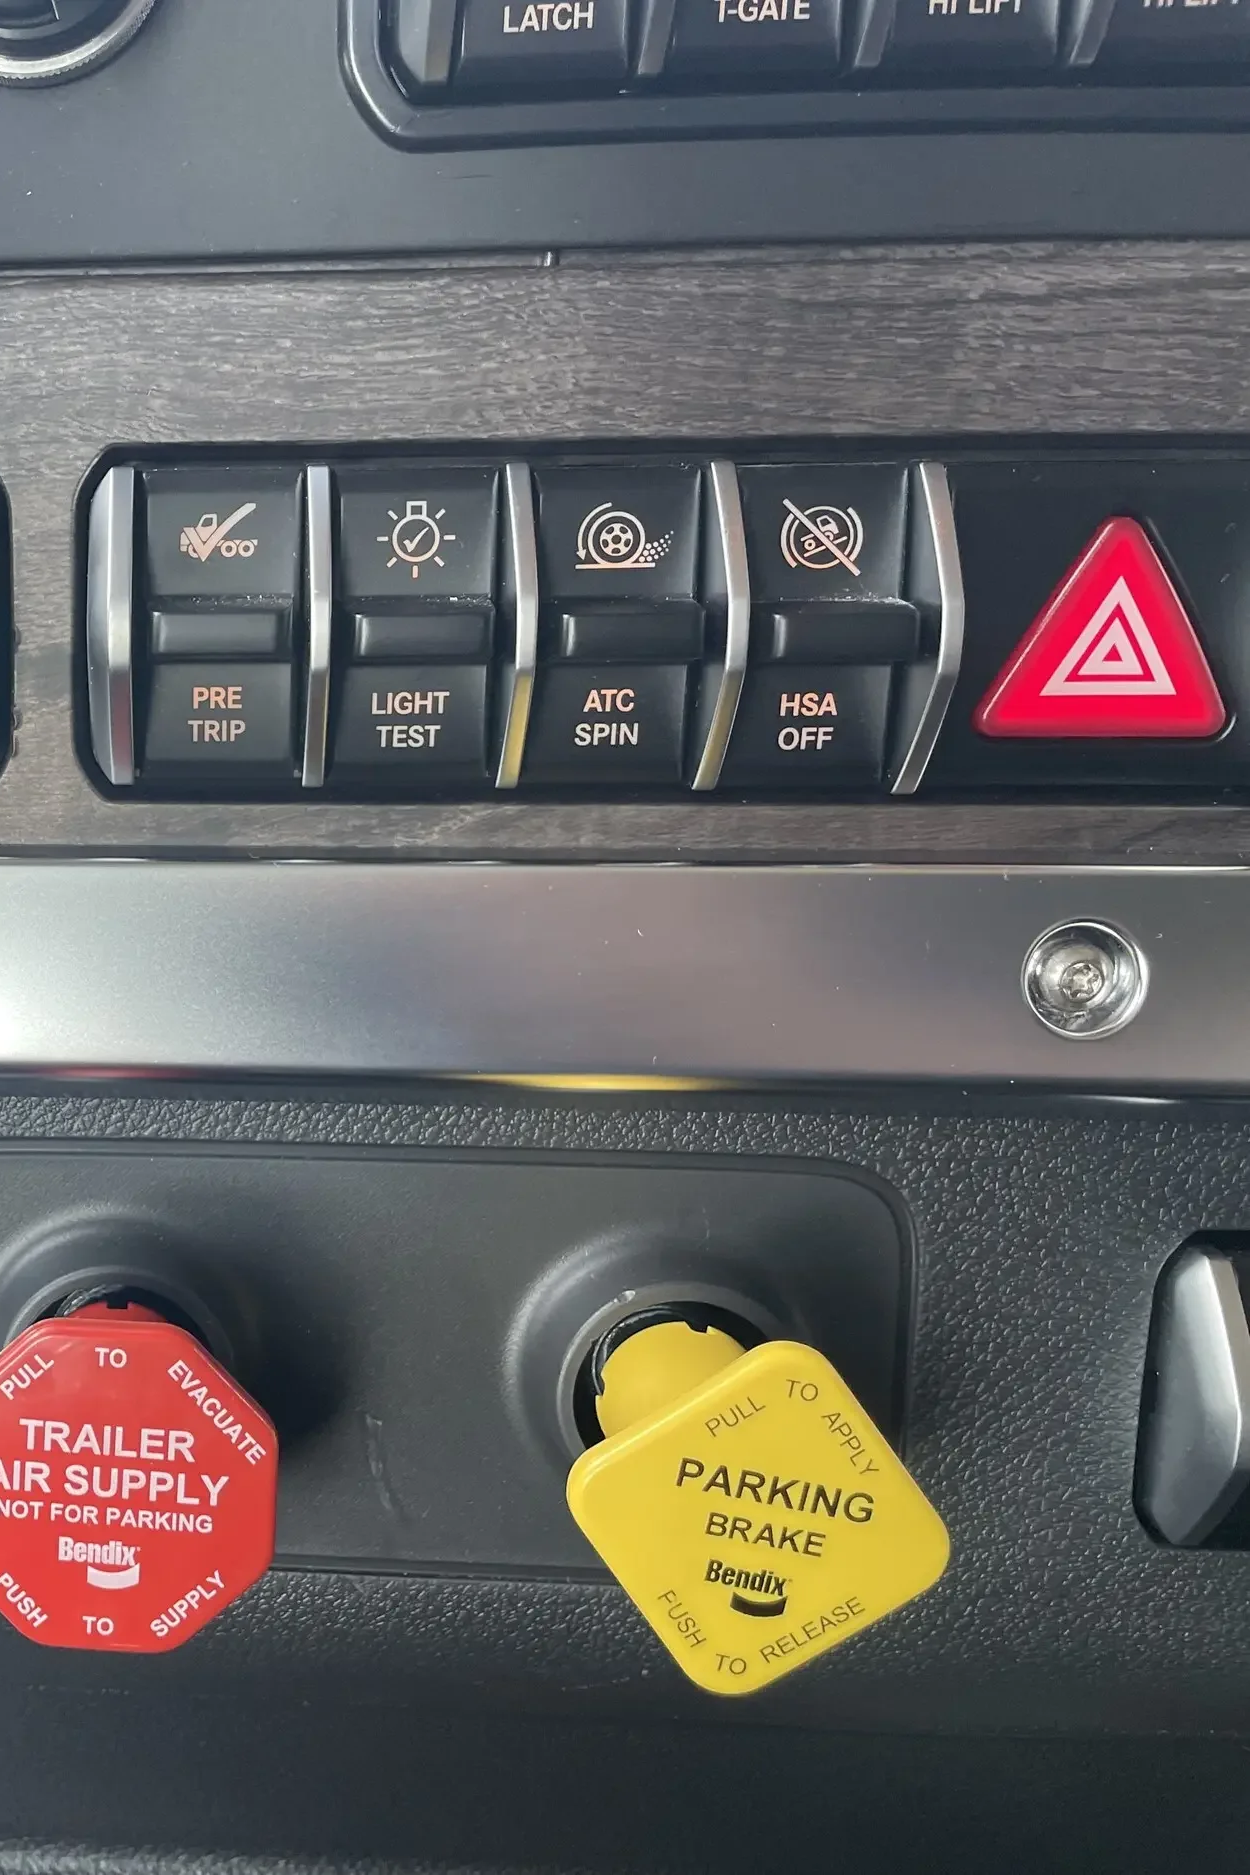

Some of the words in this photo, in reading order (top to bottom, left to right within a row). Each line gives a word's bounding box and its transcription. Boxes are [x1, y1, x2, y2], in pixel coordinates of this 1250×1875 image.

[504, 2, 593, 32] LATCH
[194, 687, 242, 708] PRE
[372, 692, 449, 714] LIGHT
[584, 689, 634, 712] ATC
[780, 693, 837, 716] HSA
[188, 720, 245, 741] TRIP
[376, 725, 440, 747] TEST
[575, 723, 638, 745] SPIN
[778, 727, 833, 750] OFF
[0, 1354, 54, 1400] PULL
[95, 1348, 126, 1368] TO
[168, 1360, 266, 1464] EVACUATE
[19, 1418, 196, 1462] TRAILER
[705, 1397, 766, 1437] PULL
[787, 1380, 818, 1401] TO
[821, 1411, 879, 1477] APPLY
[63, 1465, 229, 1506] SUPPLY
[676, 1457, 875, 1523] PARKING
[51, 1503, 98, 1524] FOR
[106, 1507, 213, 1533] PARKING
[704, 1512, 826, 1557] BRAKE
[58, 1536, 136, 1566] Bendix
[704, 1559, 788, 1596] Bendix
[83, 1616, 113, 1635] TO
[151, 1570, 224, 1636] SUPPLY
[658, 1589, 707, 1648] PUSH
[716, 1654, 746, 1674] TO
[759, 1596, 866, 1664] RELEASE
